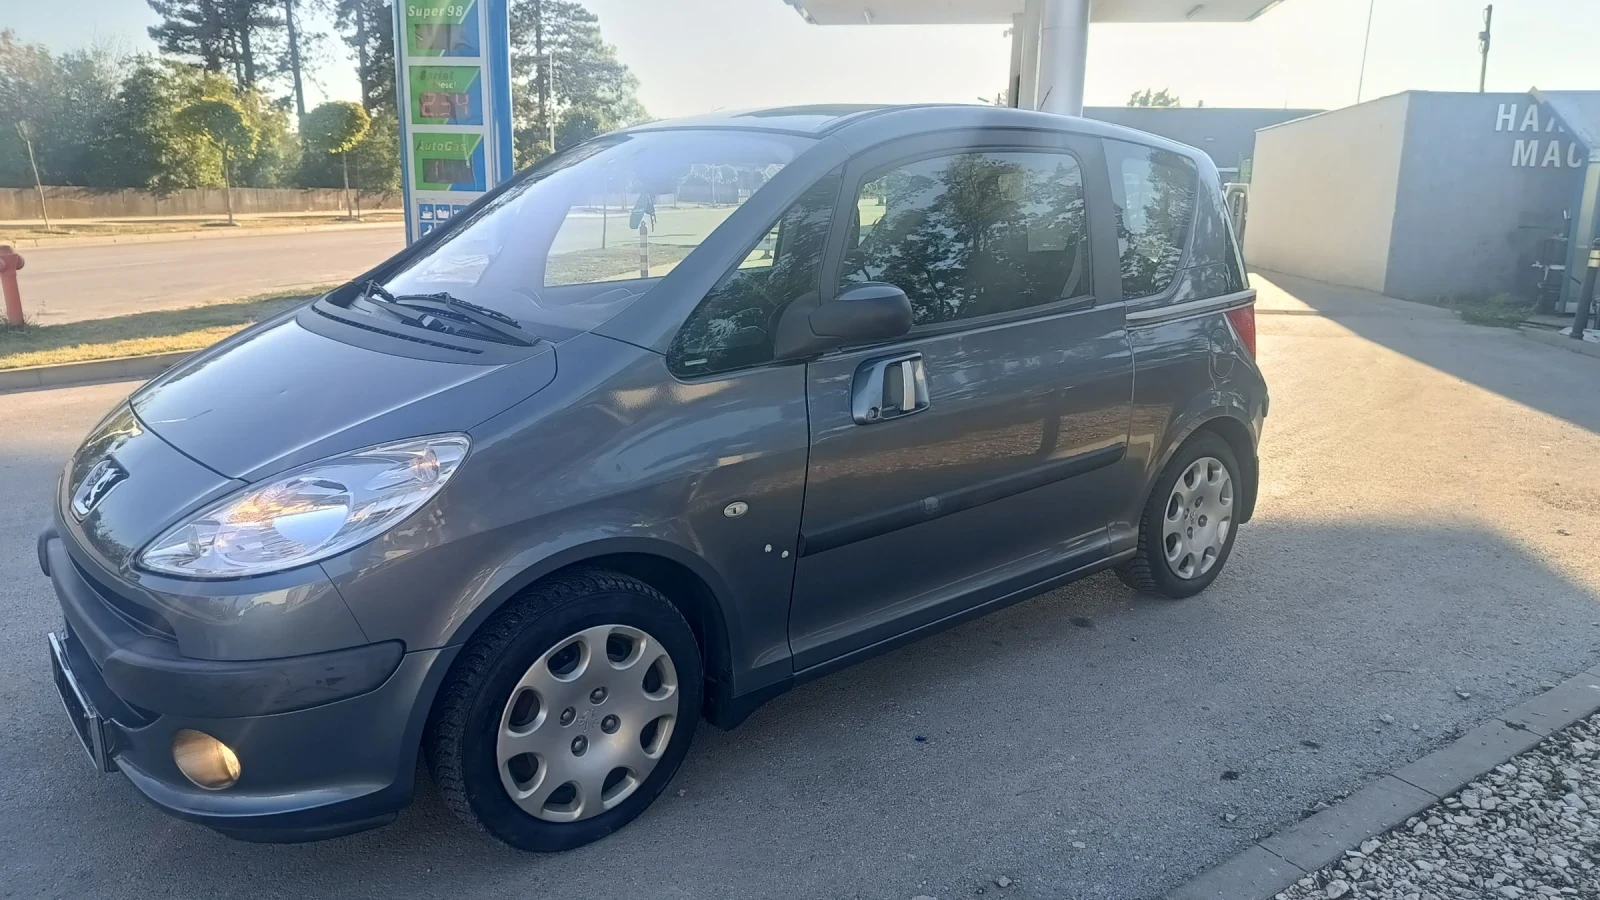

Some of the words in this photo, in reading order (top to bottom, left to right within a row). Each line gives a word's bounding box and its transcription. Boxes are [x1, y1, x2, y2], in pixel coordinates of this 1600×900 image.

[407, 5, 445, 19] Super
[447, 5, 464, 17] 98
[416, 140, 467, 152] AutoGas
